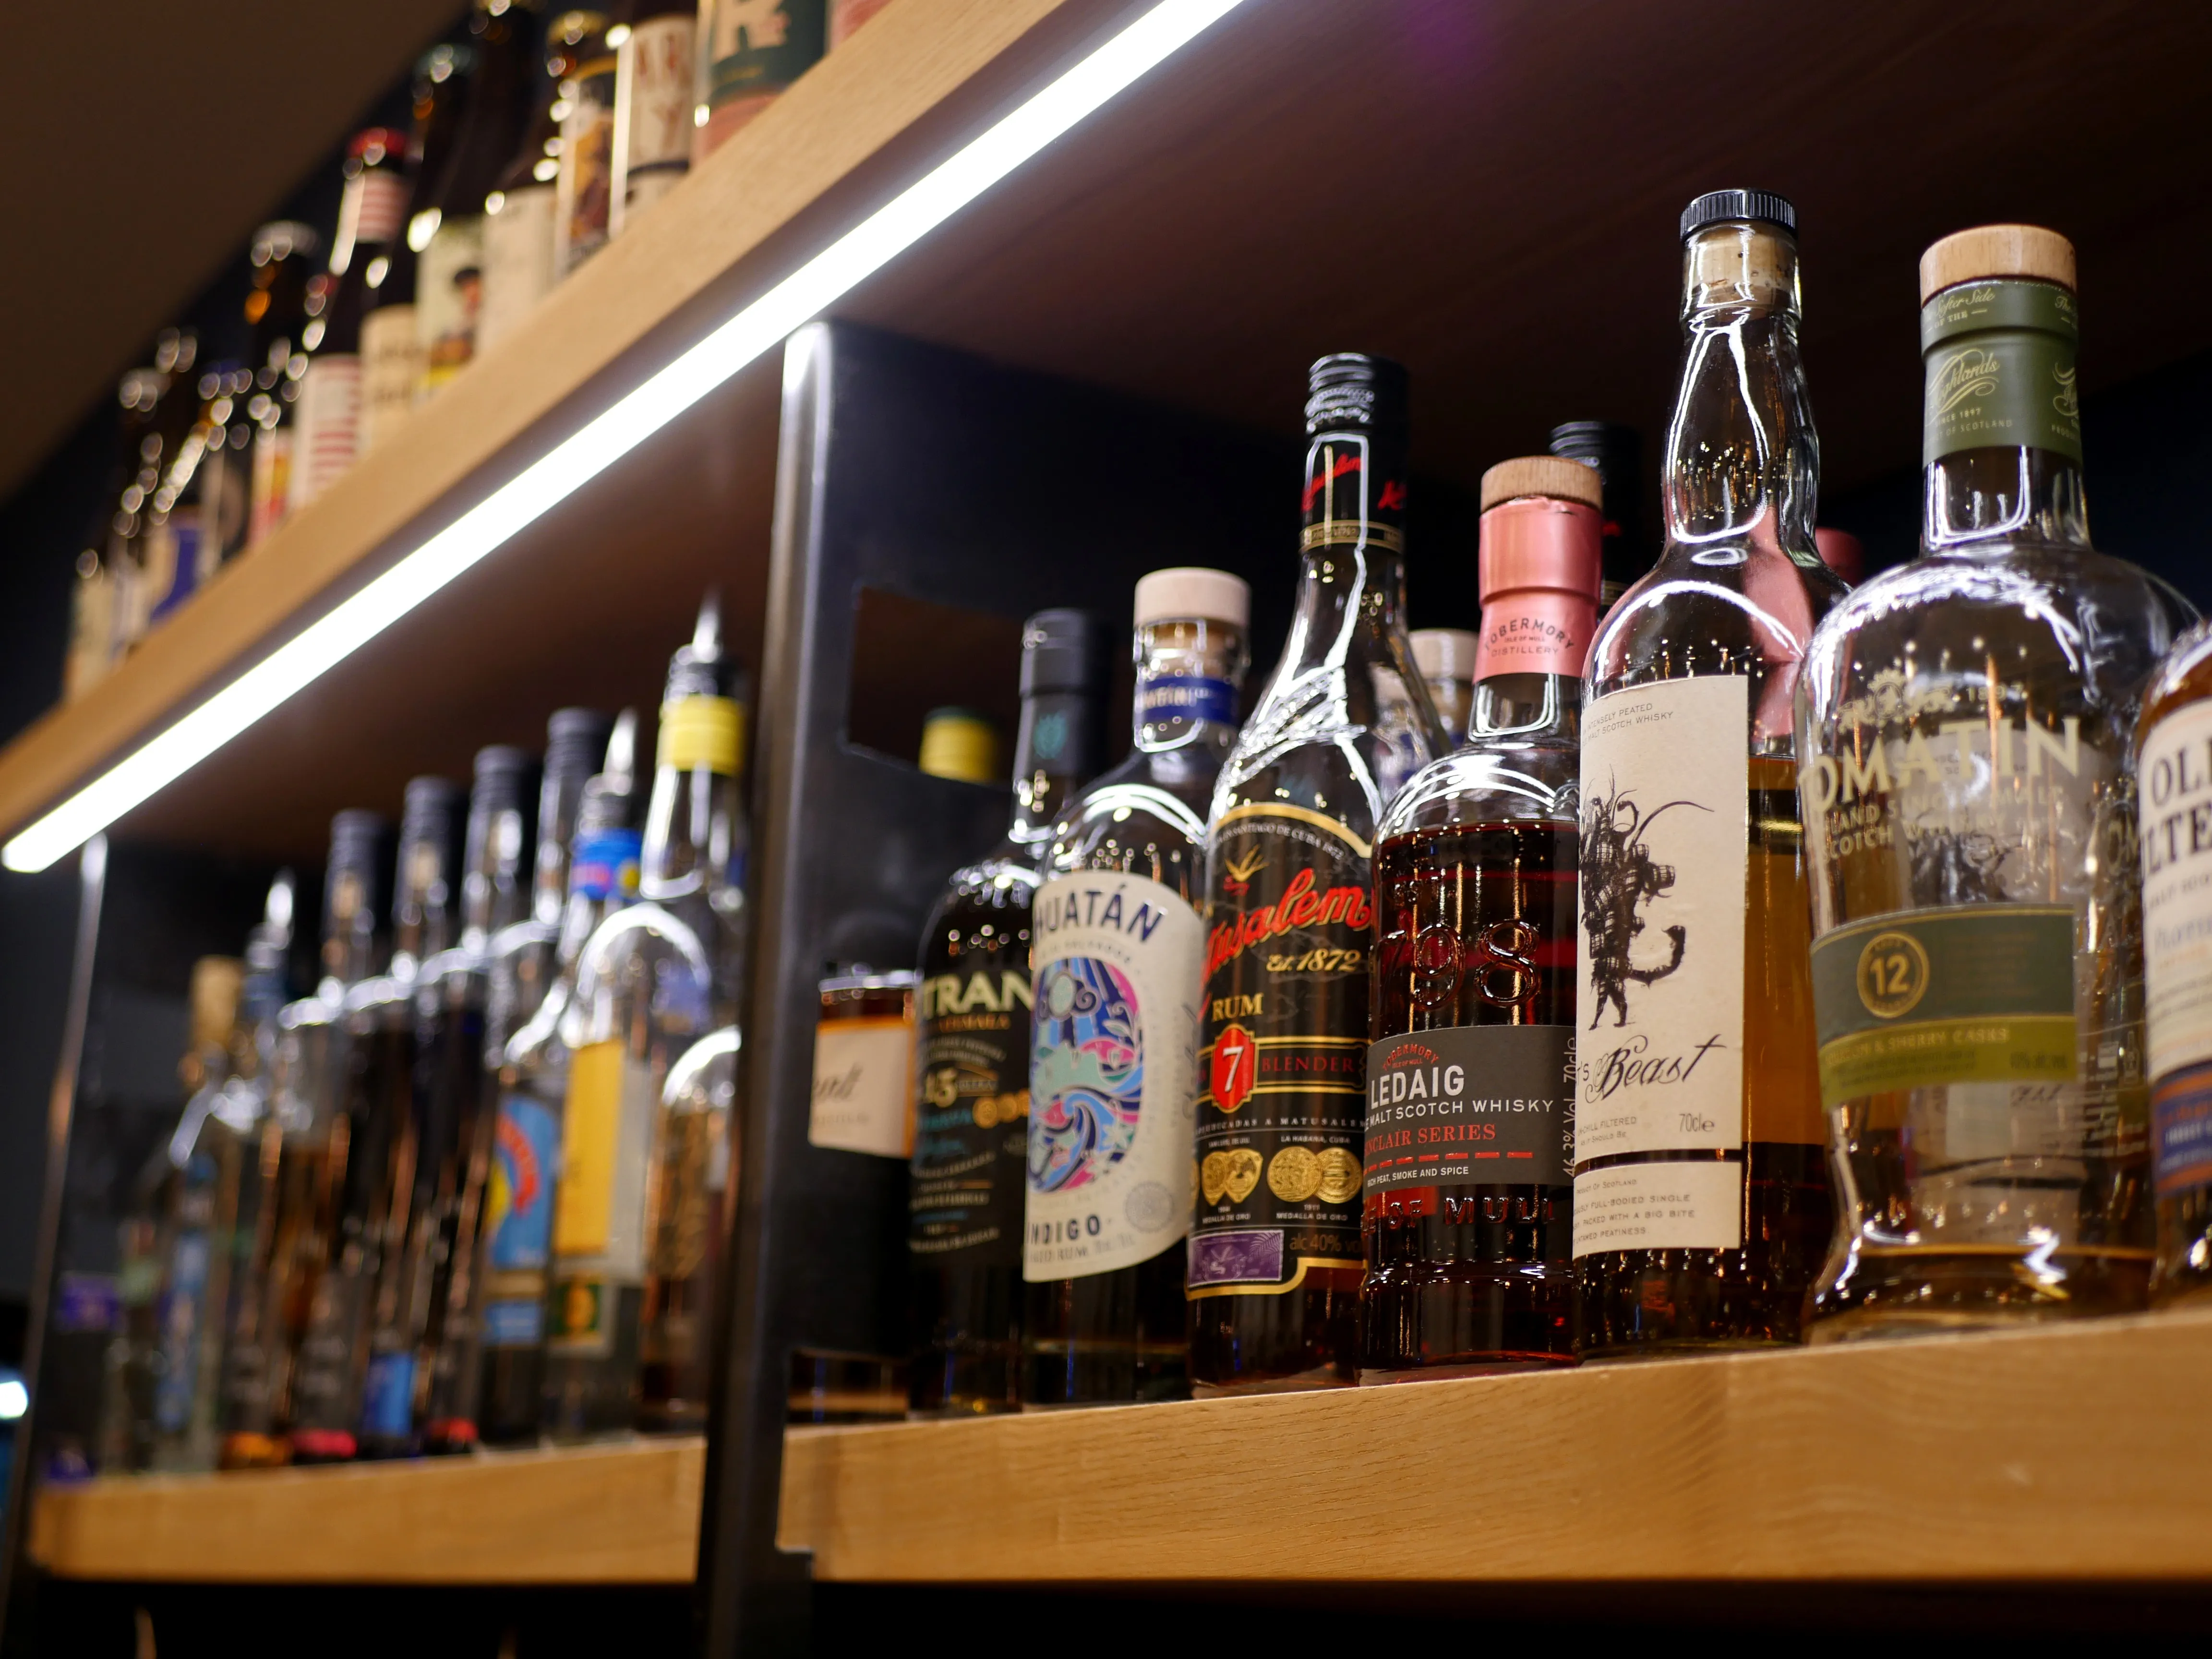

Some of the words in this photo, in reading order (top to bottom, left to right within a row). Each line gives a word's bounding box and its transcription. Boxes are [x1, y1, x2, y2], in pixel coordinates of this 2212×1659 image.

[1960, 420, 2013, 433] SCOTLAND
[1491, 646, 1559, 657] DISTILLERY
[1619, 703, 1653, 717] PEATED
[1602, 719, 1632, 734] SCOTCH
[1635, 711, 1673, 724] WHISKY
[2152, 734, 2212, 808] OL
[1276, 823, 1292, 837] DE
[1291, 828, 1322, 849] CUBA
[1265, 952, 1293, 973] Est.
[1296, 947, 1361, 973] 1872
[1870, 954, 1910, 997] 12
[1212, 992, 1264, 1023] RUM
[1887, 1031, 1947, 1050] SHERRY
[1952, 1028, 2010, 1045] CASKS
[1382, 1044, 1439, 1071] TOBERMORY
[1222, 1046, 1244, 1093] 7
[1261, 1056, 1355, 1073] BLENDER
[1585, 1034, 1727, 1104] Beast
[1371, 1065, 1464, 1110] LEDAIG
[1370, 1109, 1392, 1128] MALT
[1395, 1101, 1463, 1119] SCOTCH
[1472, 1099, 1554, 1112] WHISKY
[1600, 1116, 1637, 1130] FILTERED
[1329, 1136, 1351, 1144] CUBA
[1418, 1124, 1496, 1144] SERIES
[1591, 1133, 1613, 1144] SHOULD
[1616, 1130, 1627, 1139] BE
[1392, 1170, 1418, 1181] SMOKE
[1420, 1168, 1438, 1177] AND
[1441, 1166, 1469, 1176] SPICE
[1602, 1178, 1637, 1189] SCOTLAND
[1590, 1195, 1645, 1209] FULL-BODIED
[1649, 1194, 1691, 1203] SINGLE
[1275, 1212, 1314, 1221] MEDALLA
[1316, 1213, 1327, 1221] DE
[1329, 1214, 1348, 1222] ORO
[1583, 1215, 1606, 1226] PACKED
[1609, 1212, 1629, 1221] WITH
[1644, 1210, 1663, 1219] BIG
[1669, 1210, 1696, 1218] BITE
[1289, 1231, 1308, 1251] alc
[1309, 1233, 1343, 1252] 40%
